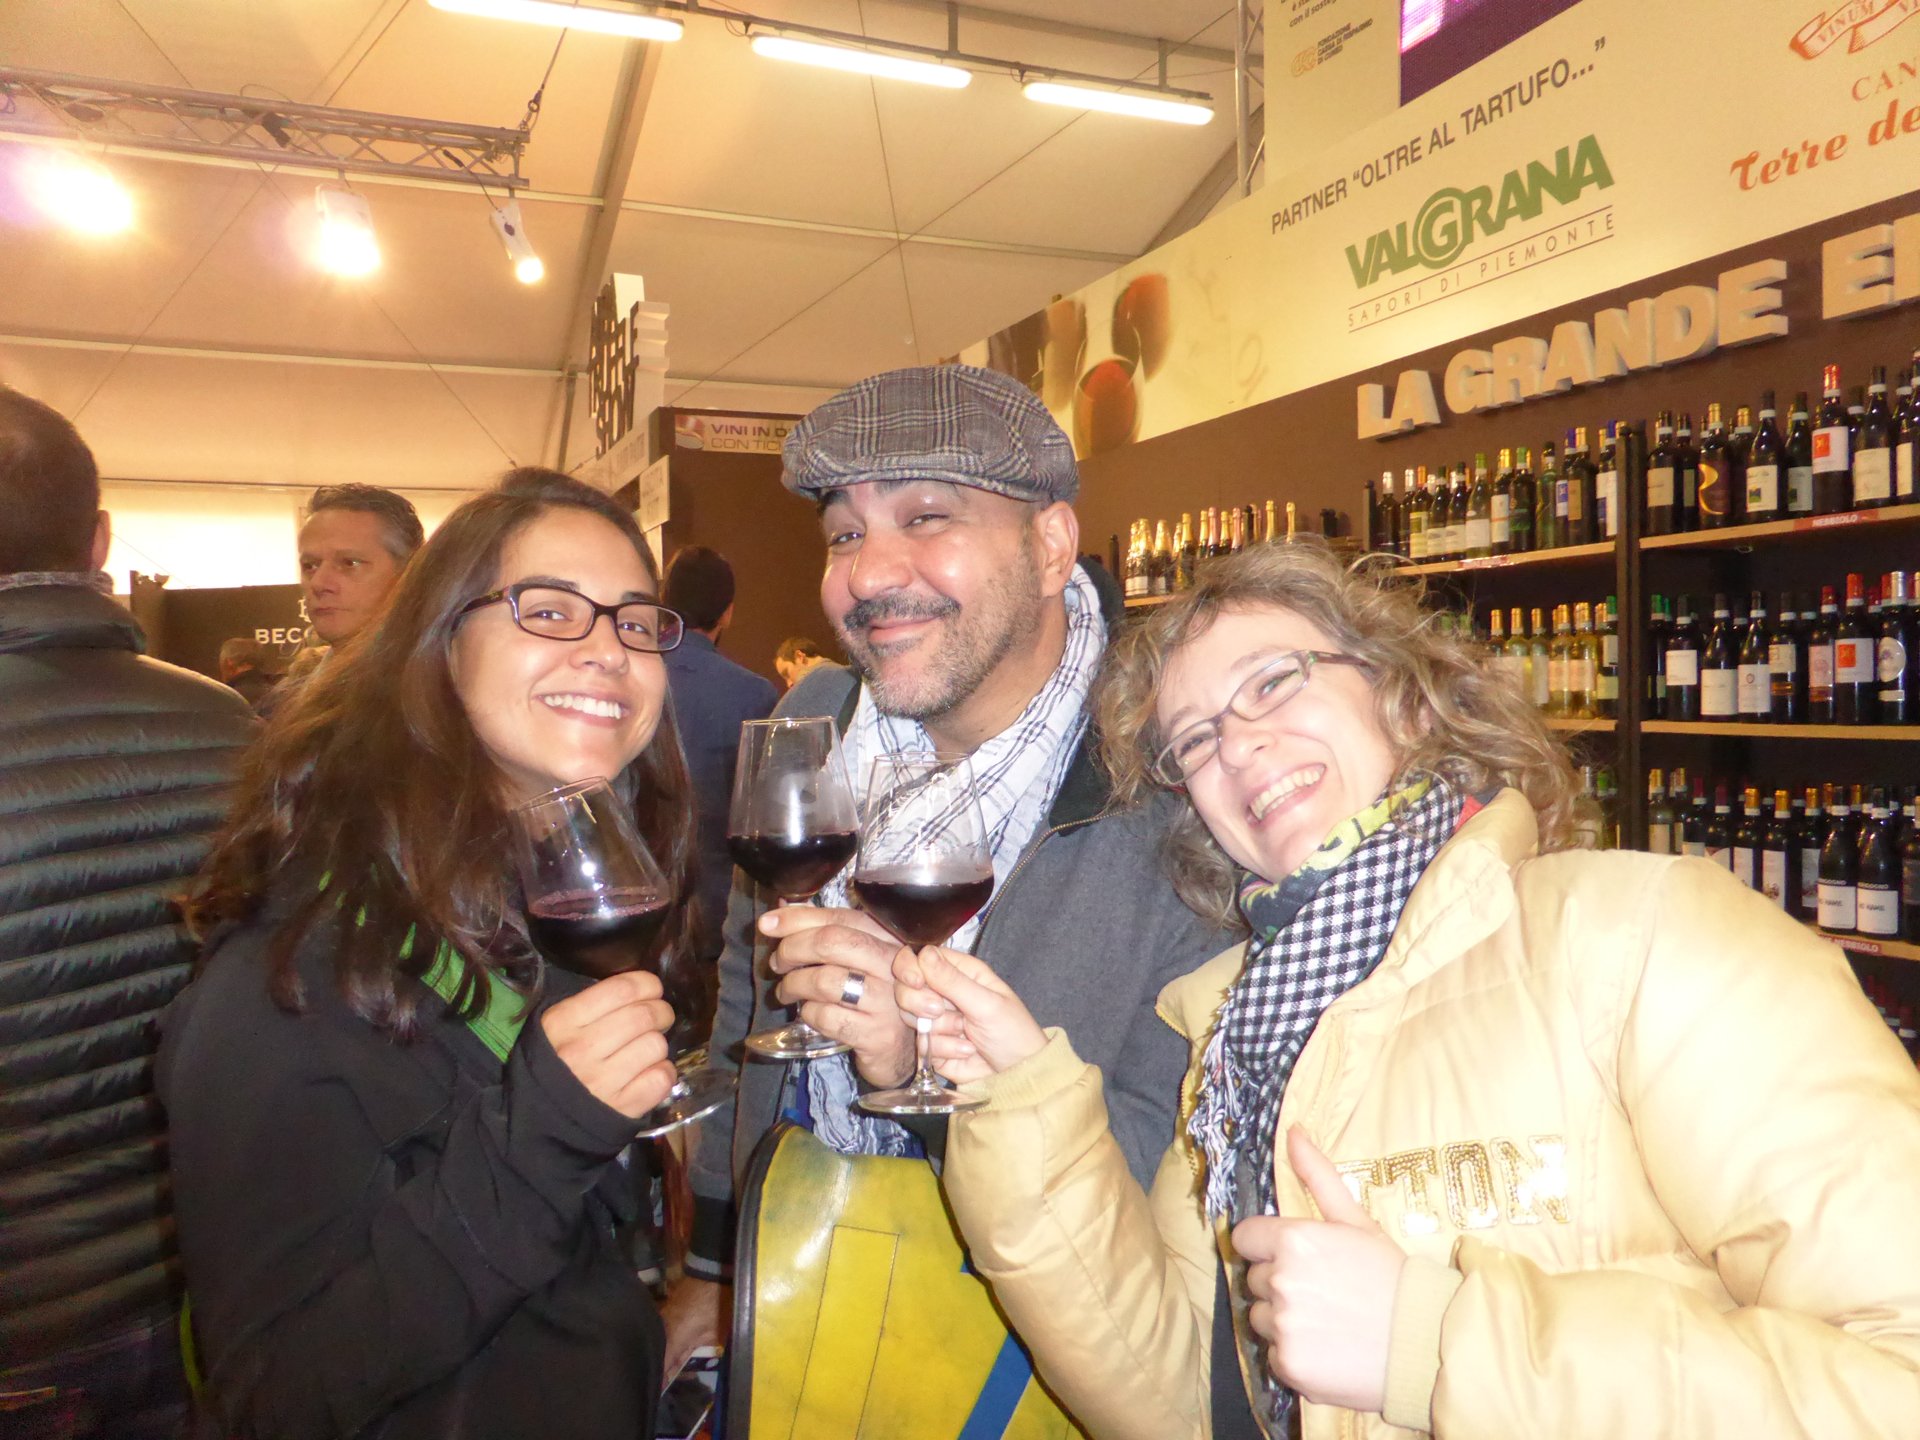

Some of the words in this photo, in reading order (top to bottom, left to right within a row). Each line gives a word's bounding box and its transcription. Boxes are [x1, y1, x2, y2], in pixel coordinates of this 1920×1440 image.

[1817, 0, 1875, 43] VINUM
[1271, 178, 1348, 235] PARTNER
[1428, 122, 1456, 155] AL
[1730, 133, 1848, 191] Terre
[1344, 134, 1615, 289] VALGRANA
[1348, 287, 1422, 327] SAPORI
[1440, 270, 1461, 293] DI
[1480, 213, 1615, 278] PIEMONTE
[1357, 369, 1442, 440] LA
[1444, 258, 1789, 415] GRANDE
[1822, 212, 1920, 321] E
[711, 423, 748, 436] VINI
[752, 425, 770, 437] IN
[711, 437, 750, 450] CON
